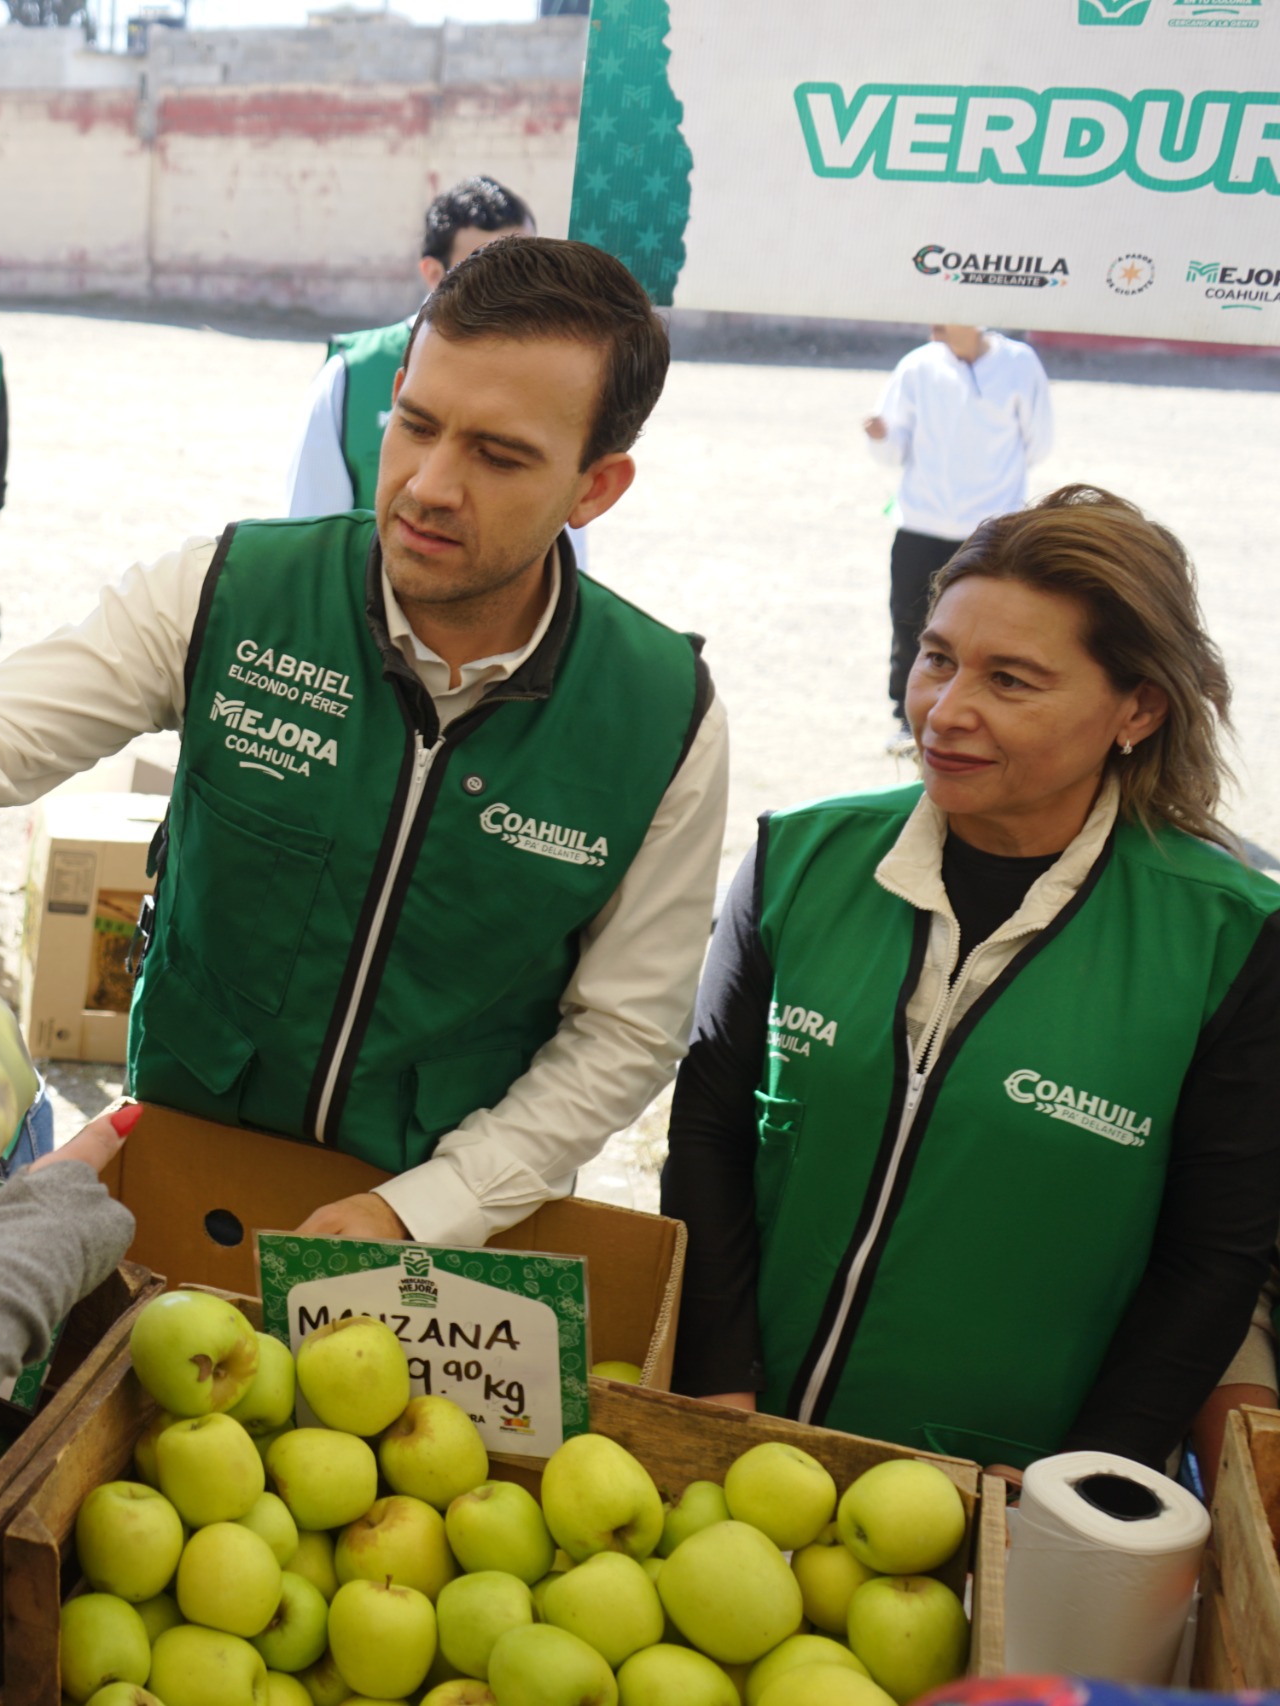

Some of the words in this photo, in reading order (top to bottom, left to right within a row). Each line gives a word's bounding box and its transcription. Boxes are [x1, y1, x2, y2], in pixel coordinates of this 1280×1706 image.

[795, 83, 1280, 194] VERDUR
[912, 245, 1070, 275] COAHUILA
[988, 275, 1041, 287] DELANTE
[228, 664, 300, 701] ELIZONDO
[300, 691, 349, 718] PÉREZ
[236, 639, 354, 700] GABRIEL
[210, 691, 338, 767] MEJORA
[224, 734, 310, 777] COAHUILA
[479, 802, 609, 857] COAHUILA
[541, 845, 581, 862] DELANTE
[1004, 1068, 1153, 1137] COAHUILA
[1081, 1116, 1129, 1141] DELANTE
[398, 1284, 439, 1297] MEJORA
[298, 1305, 521, 1351] MZANA
